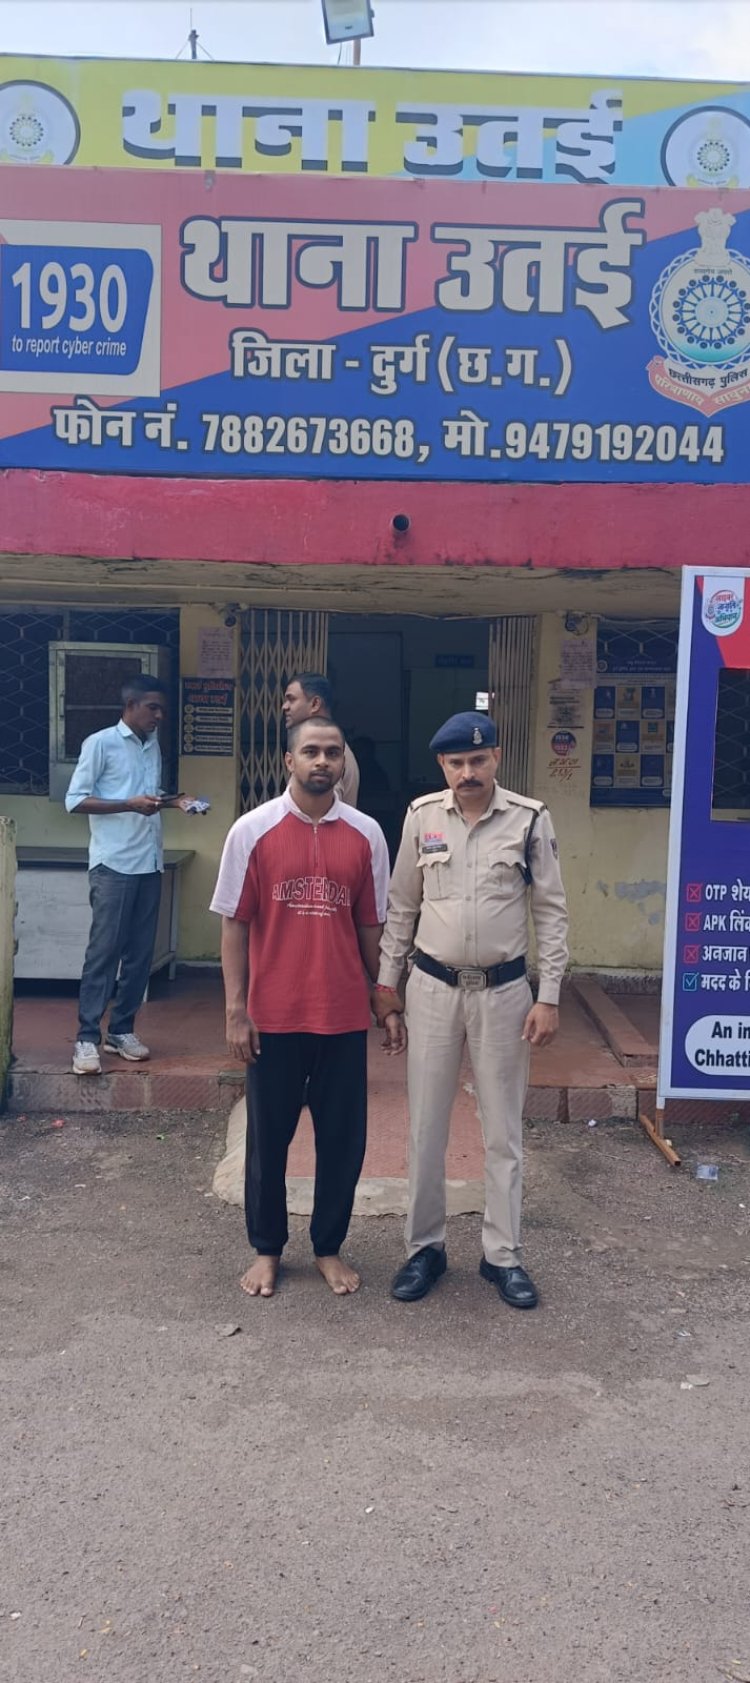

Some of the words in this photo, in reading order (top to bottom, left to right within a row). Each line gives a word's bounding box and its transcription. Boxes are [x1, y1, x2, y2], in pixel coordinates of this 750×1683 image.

[122, 88, 376, 172] थाना
[396, 88, 623, 184] उतई
[181, 216, 416, 311] थाना
[432, 199, 644, 329] उतई
[12, 262, 127, 333] 1930
[12, 336, 23, 352] to
[26, 336, 60, 358] report
[62, 336, 94, 359] cyber
[96, 337, 127, 356] crime
[231, 330, 337, 380] जिला
[370, 335, 430, 395] दुर्ग
[720, 368, 748, 388] पुलिस
[53, 398, 137, 446] फोन
[144, 403, 188, 450] नं.
[202, 414, 430, 462] 7882673668,
[705, 885, 727, 900] OTP
[703, 914, 727, 931] APK
[702, 945, 747, 961] अनजान
[701, 974, 727, 990] मदद
[729, 968, 741, 990] के
[711, 1021, 732, 1038] An
